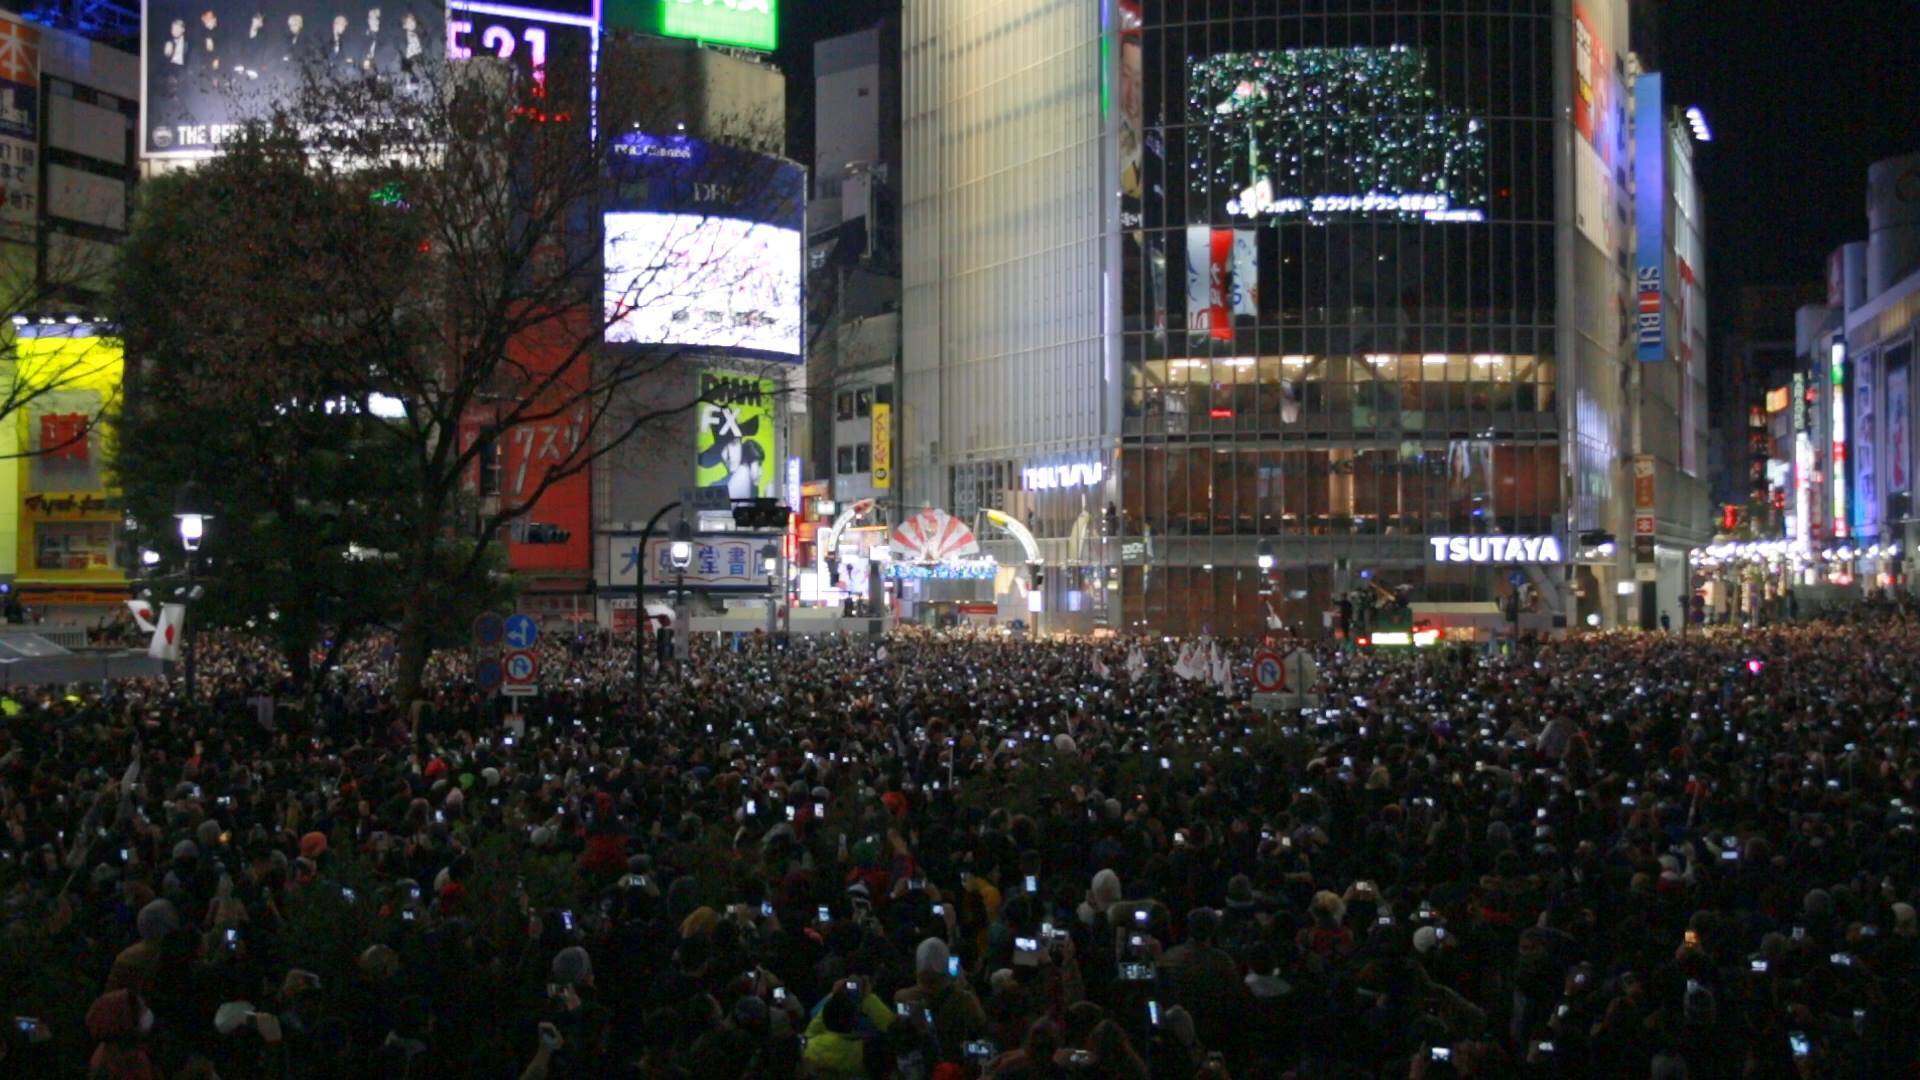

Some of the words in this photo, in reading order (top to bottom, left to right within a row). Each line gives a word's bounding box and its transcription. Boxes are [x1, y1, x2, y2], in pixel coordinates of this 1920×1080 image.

[177, 126, 206, 144] THE
[1638, 266, 1661, 343] SEIBU
[701, 403, 742, 437] FX
[1430, 536, 1560, 562] TSUTAYA
